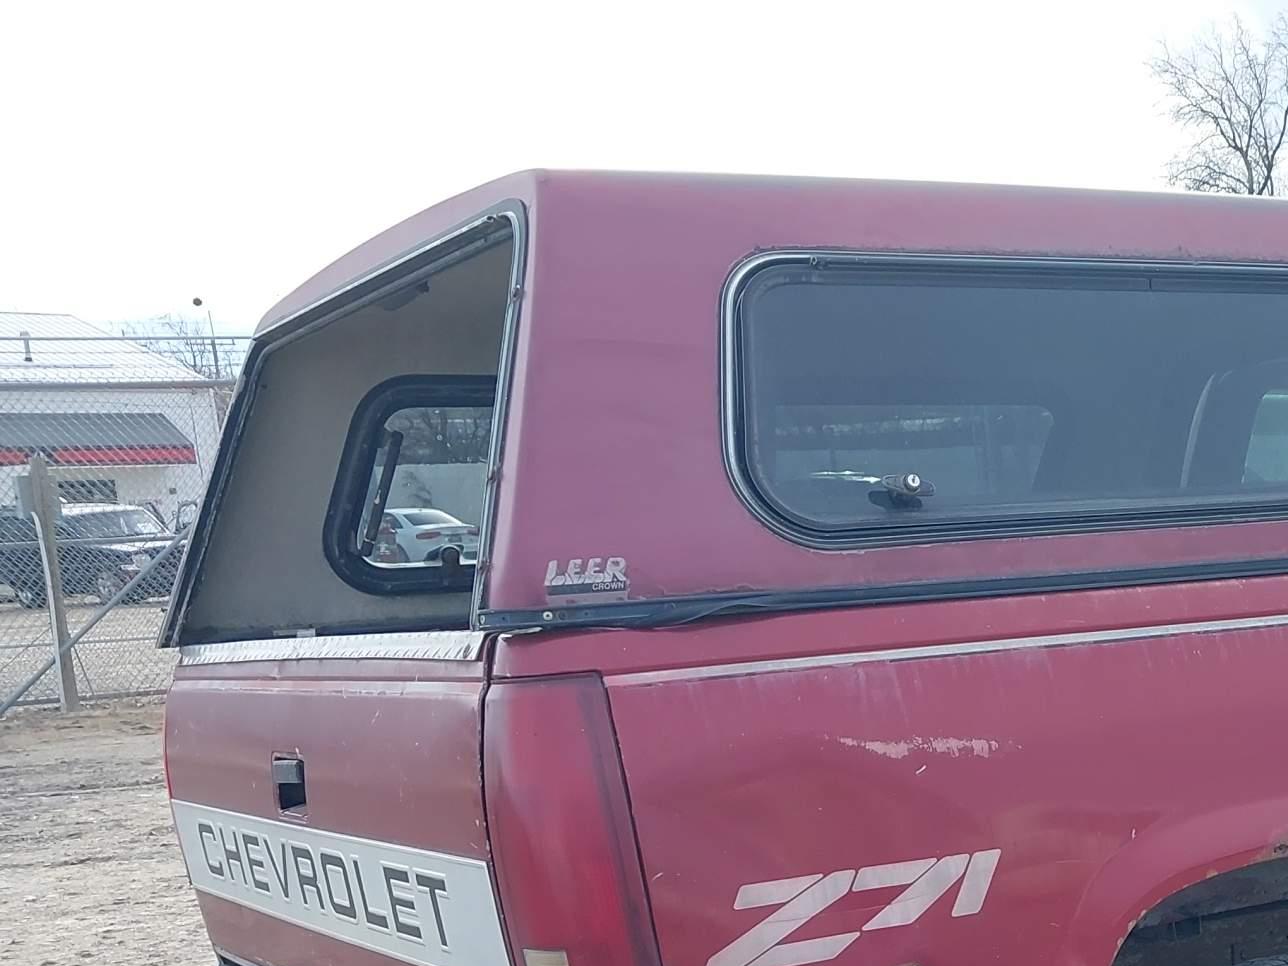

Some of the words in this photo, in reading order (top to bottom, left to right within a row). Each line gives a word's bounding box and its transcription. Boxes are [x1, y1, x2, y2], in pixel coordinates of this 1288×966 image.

[543, 556, 627, 586] LEER
[591, 581, 625, 591] CROWN
[197, 811, 450, 952] CHEVROLET
